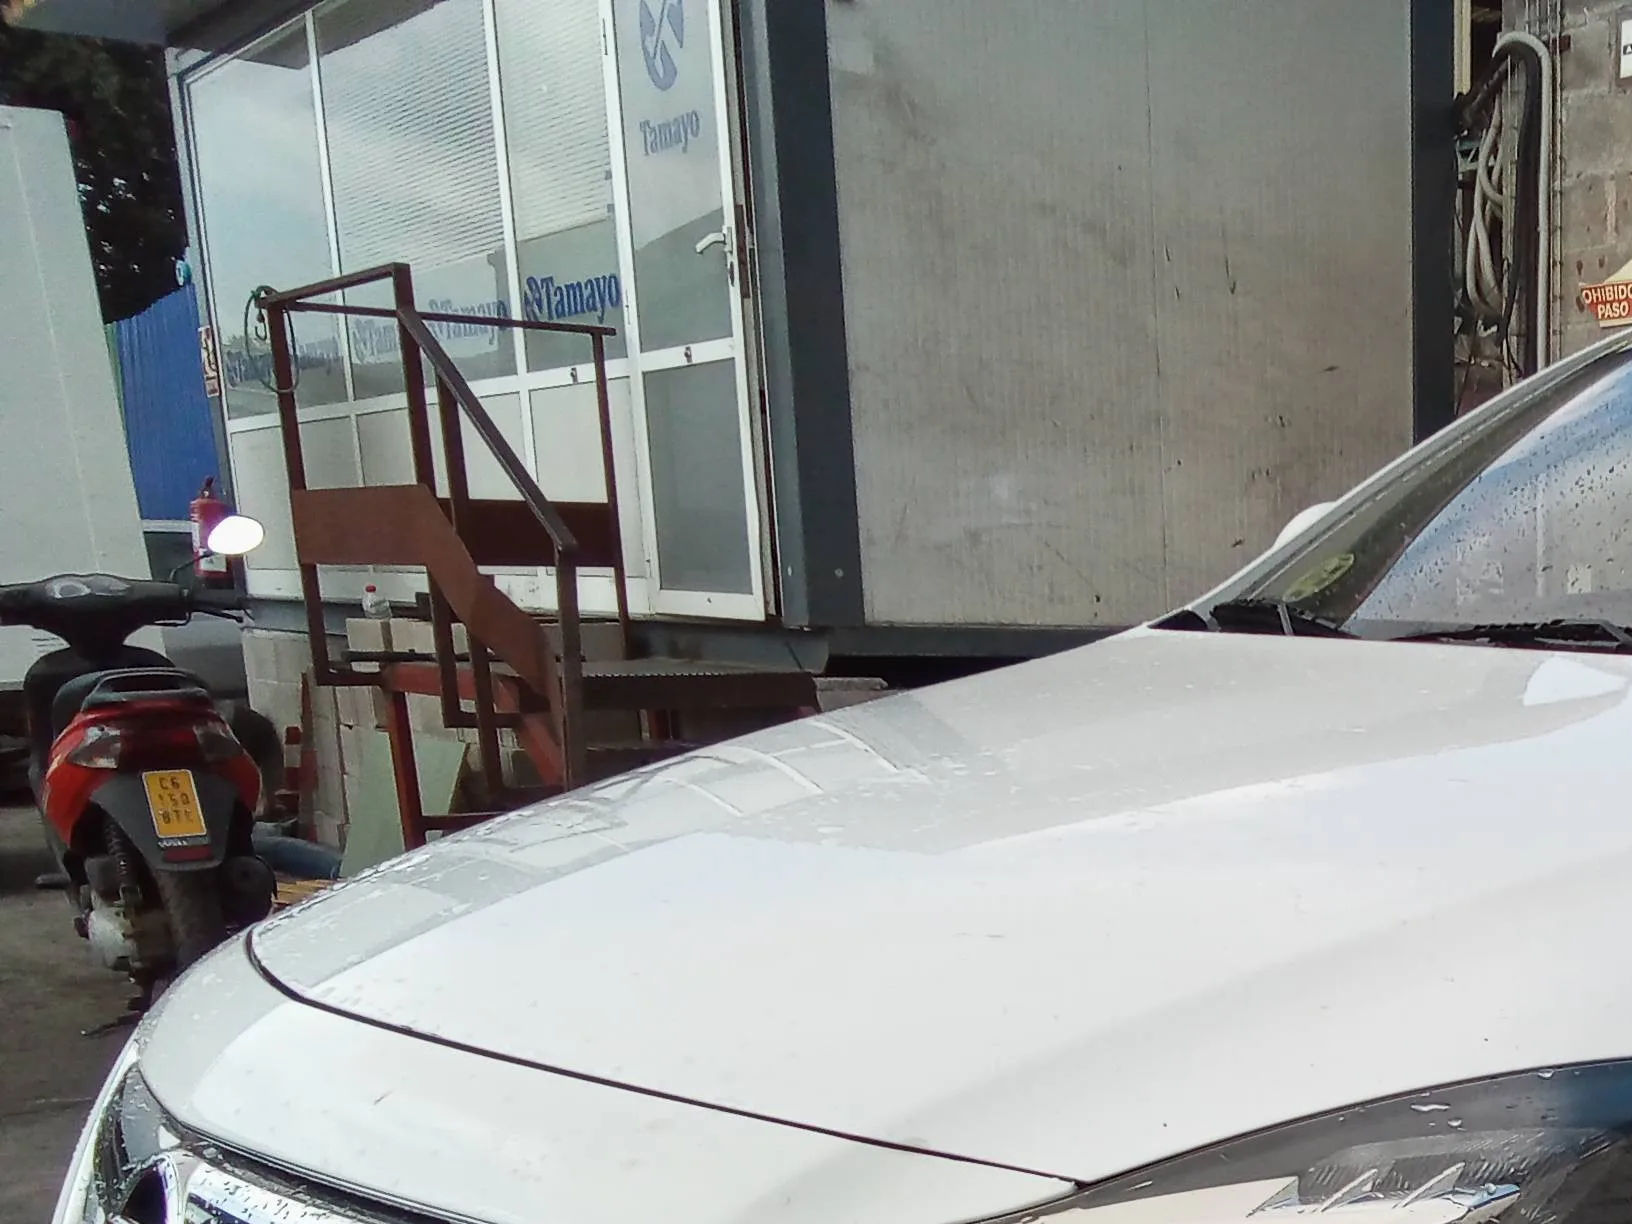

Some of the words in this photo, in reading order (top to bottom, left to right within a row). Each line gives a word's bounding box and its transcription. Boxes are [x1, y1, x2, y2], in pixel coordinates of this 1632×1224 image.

[640, 110, 700, 156] Tamayo
[540, 272, 622, 324] Tamayo
[1597, 301, 1629, 319] PASO
